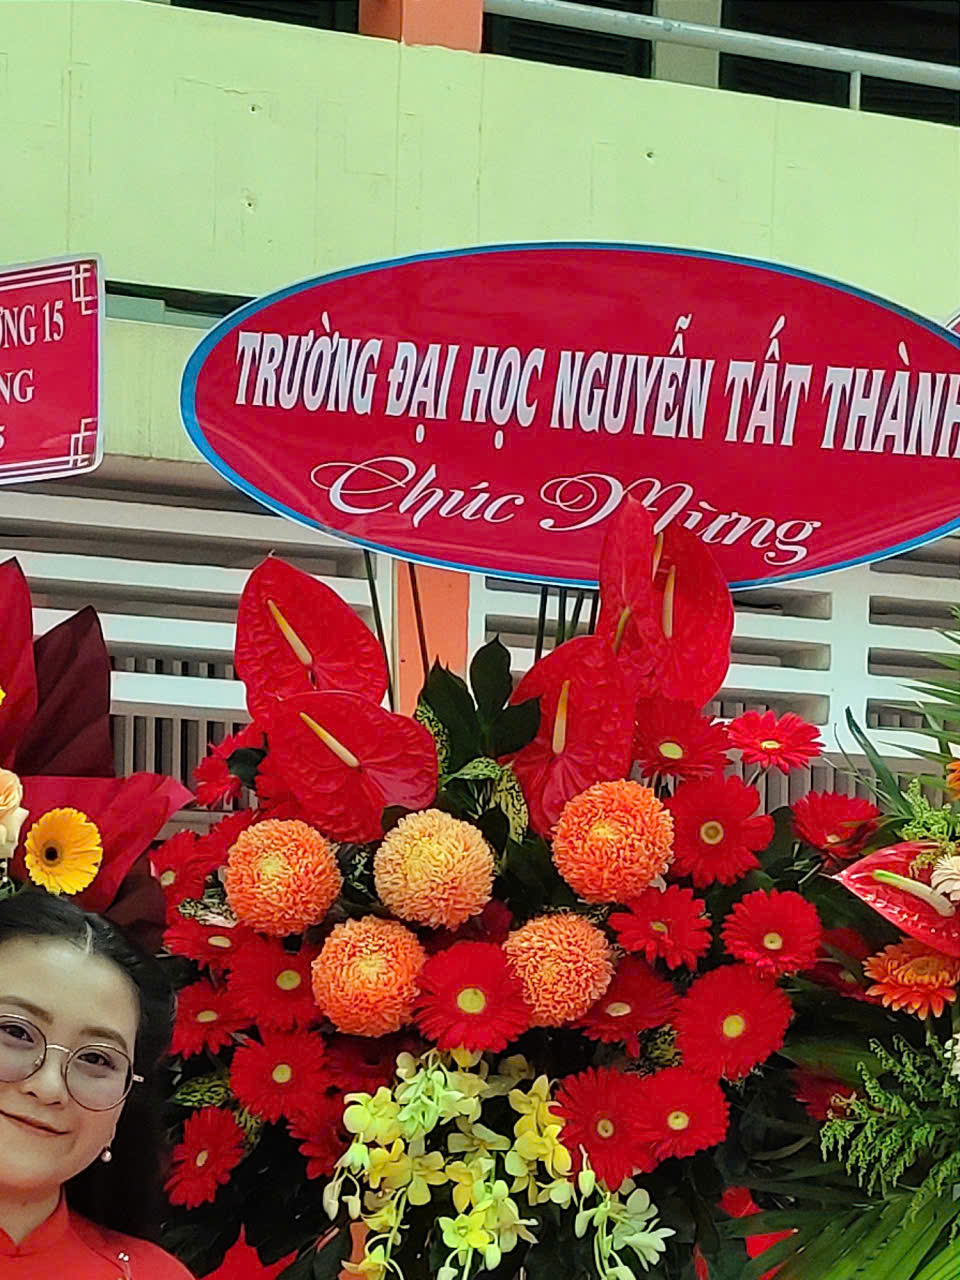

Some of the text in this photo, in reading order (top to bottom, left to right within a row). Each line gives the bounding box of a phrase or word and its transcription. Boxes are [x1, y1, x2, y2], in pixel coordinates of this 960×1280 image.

[42, 300, 65, 344] 15
[235, 311, 960, 460] TRƯỜNG ĐẠI HỌC NGUYỄN TẤT THÀNH
[310, 456, 525, 528] Chúc
